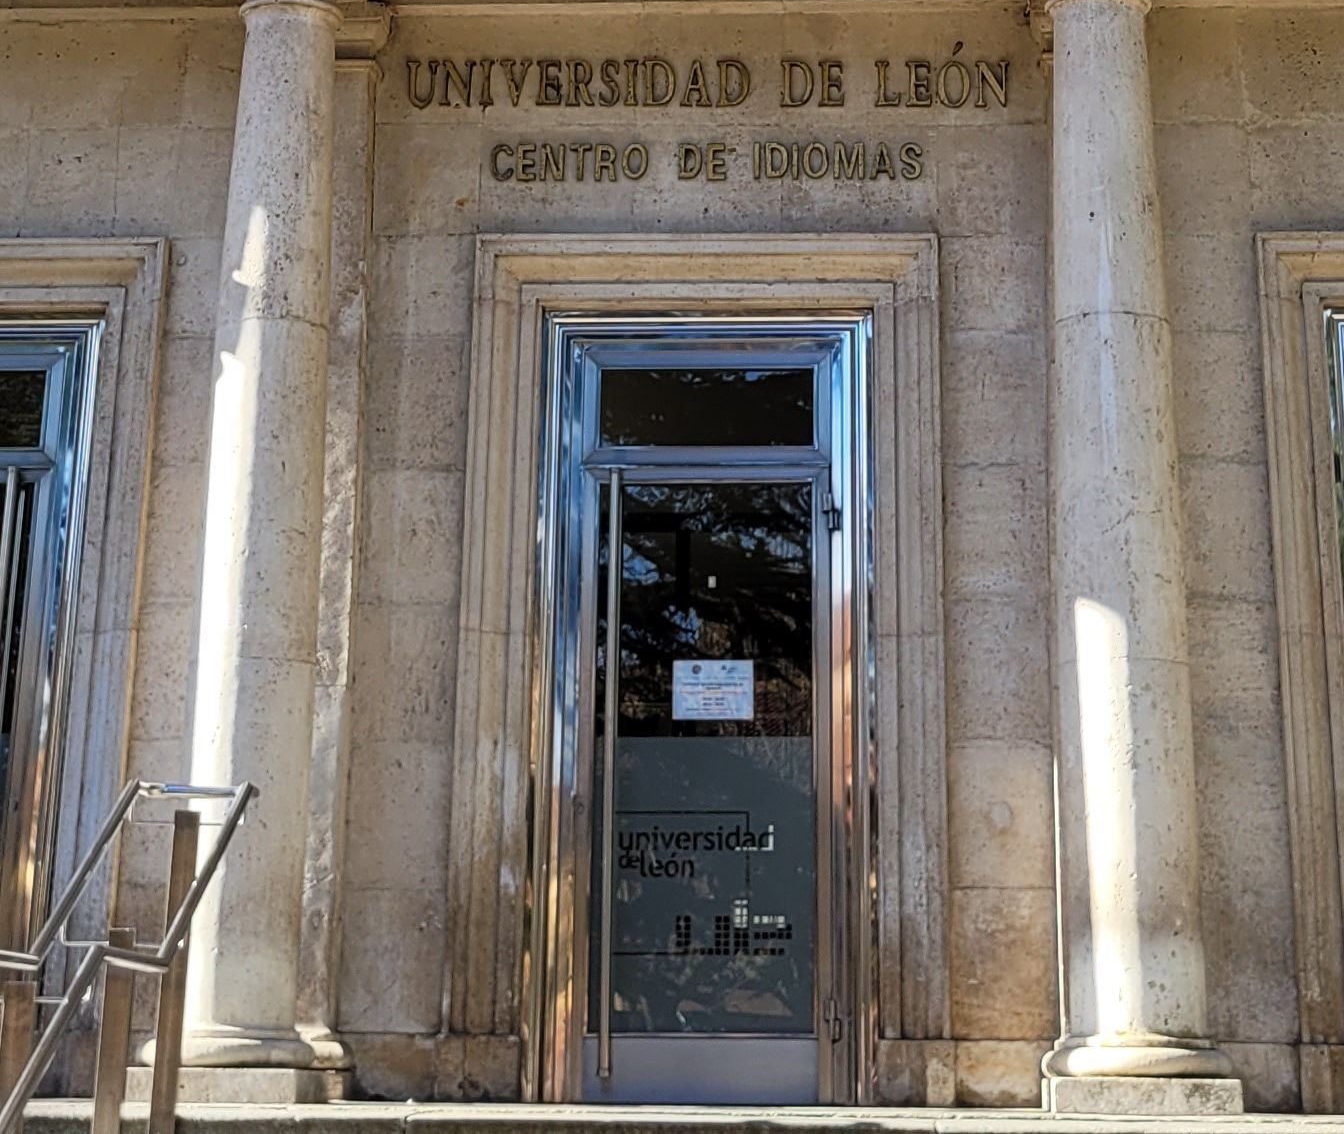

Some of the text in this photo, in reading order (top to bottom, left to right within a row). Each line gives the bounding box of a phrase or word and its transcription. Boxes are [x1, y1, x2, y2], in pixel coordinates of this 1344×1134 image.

[405, 41, 1011, 109] UNIVERSIDAD DE LEÓN
[490, 141, 925, 182] CENTRO DE IDIOMAS
[618, 825, 775, 852] universidad
